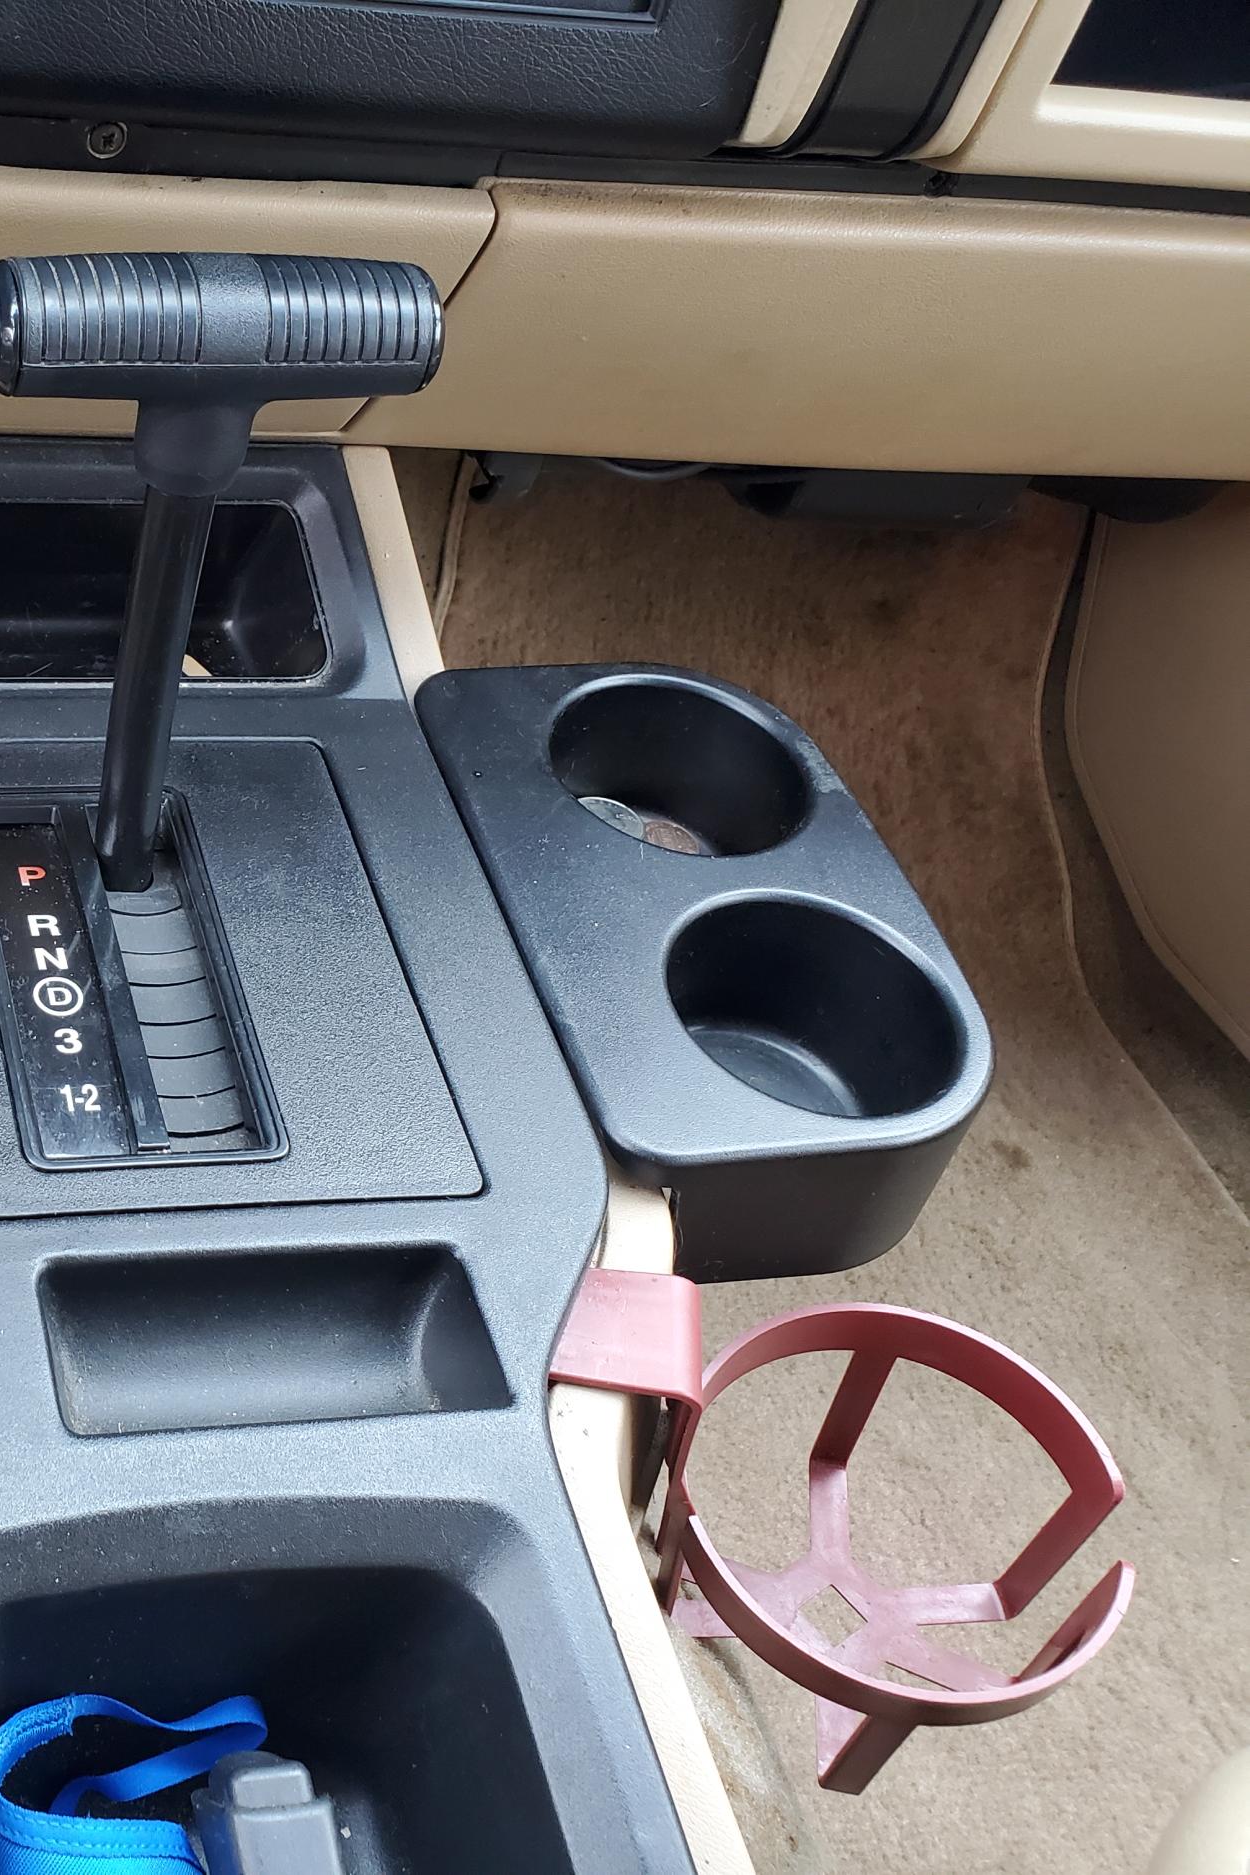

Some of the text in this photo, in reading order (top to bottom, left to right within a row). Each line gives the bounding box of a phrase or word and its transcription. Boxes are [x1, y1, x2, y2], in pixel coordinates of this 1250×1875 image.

[17, 866, 46, 887] P
[27, 914, 61, 937] R
[34, 947, 68, 971] N
[47, 987, 72, 1006] D
[54, 1028, 83, 1055] 3
[60, 1083, 101, 1112] 1-2
